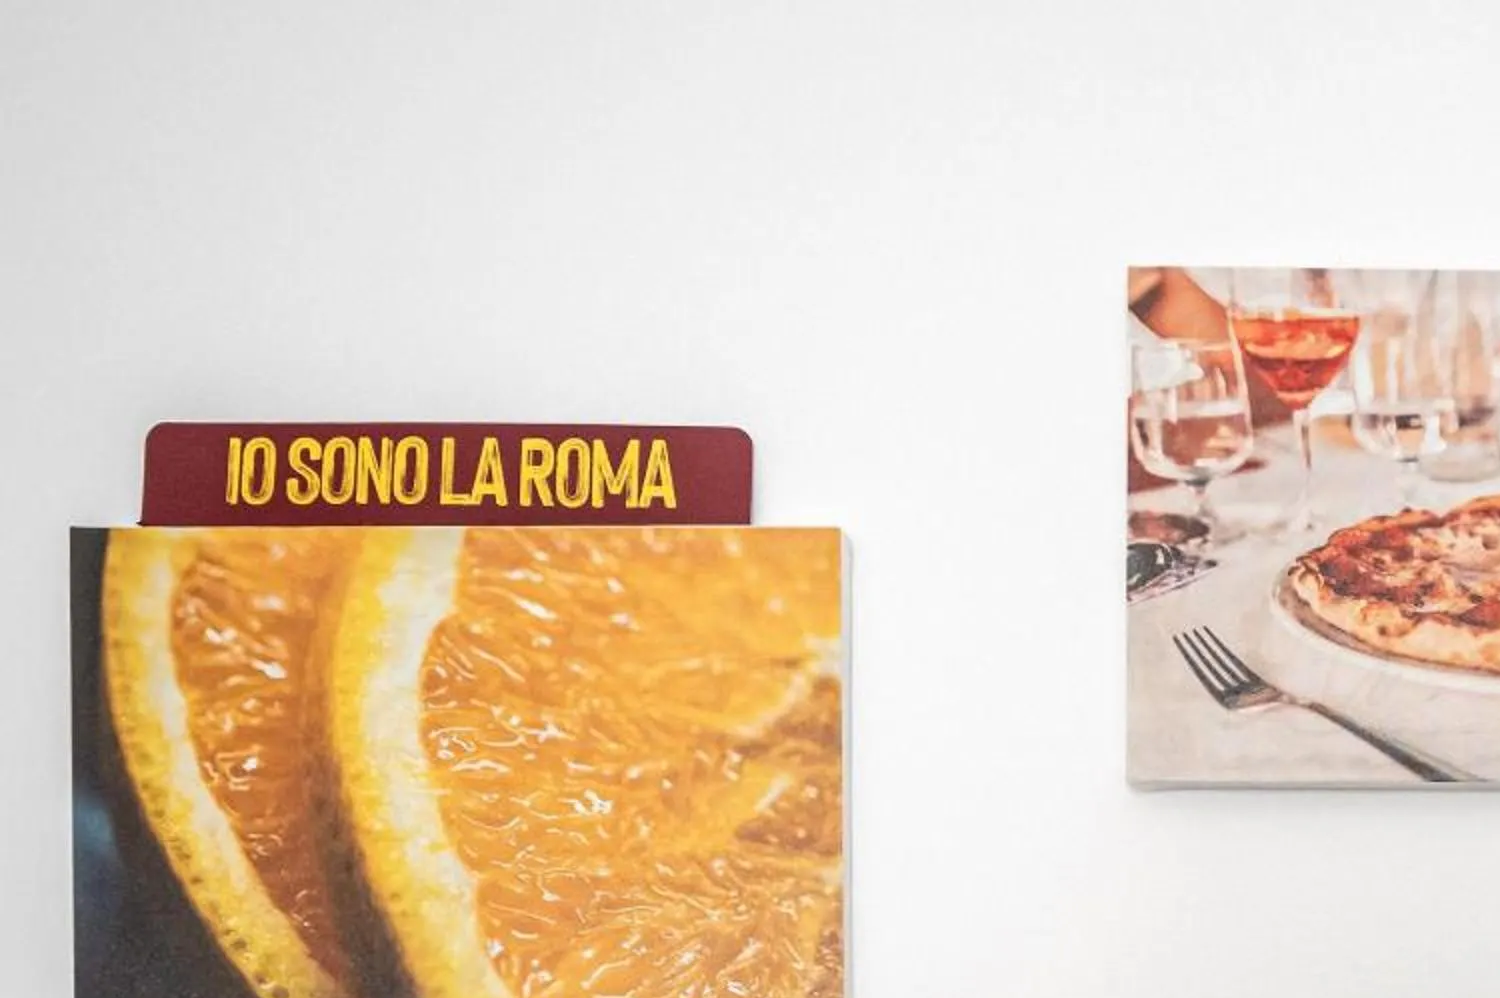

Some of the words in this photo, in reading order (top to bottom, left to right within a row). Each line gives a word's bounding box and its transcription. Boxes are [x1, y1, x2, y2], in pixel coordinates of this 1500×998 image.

[226, 436, 277, 505] IO
[286, 435, 429, 505] SONO
[439, 436, 508, 507] LA
[519, 437, 677, 509] ROMA
